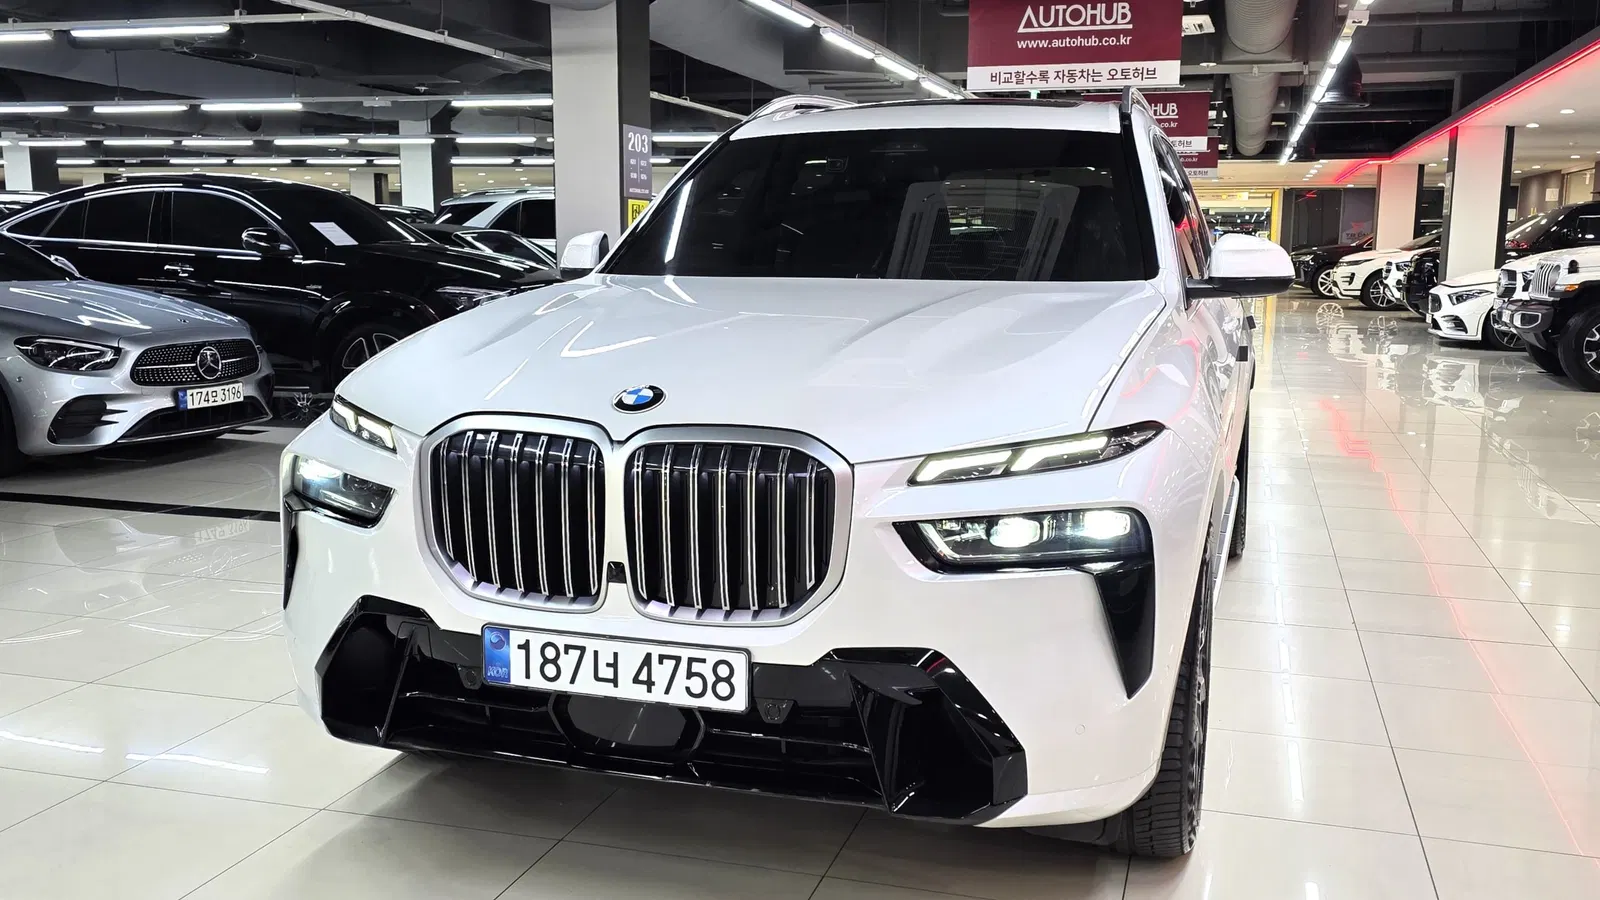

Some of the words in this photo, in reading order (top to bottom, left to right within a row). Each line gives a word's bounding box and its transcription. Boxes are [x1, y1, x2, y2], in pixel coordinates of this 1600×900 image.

[1017, 2, 1133, 33] AUTOHUB
[1017, 34, 1132, 48] www.autohub.co.kr
[990, 70, 1050, 85] 비교할수록
[1053, 68, 1103, 83] 자동차는
[1106, 67, 1157, 81] 오토허브
[1151, 103, 1178, 116] HUB
[628, 132, 648, 153] 203
[1171, 139, 1193, 148] 토허브
[189, 390, 219, 406] 174모
[220, 385, 242, 402] 3196
[517, 639, 619, 688] 187너
[632, 652, 736, 702] 4758
